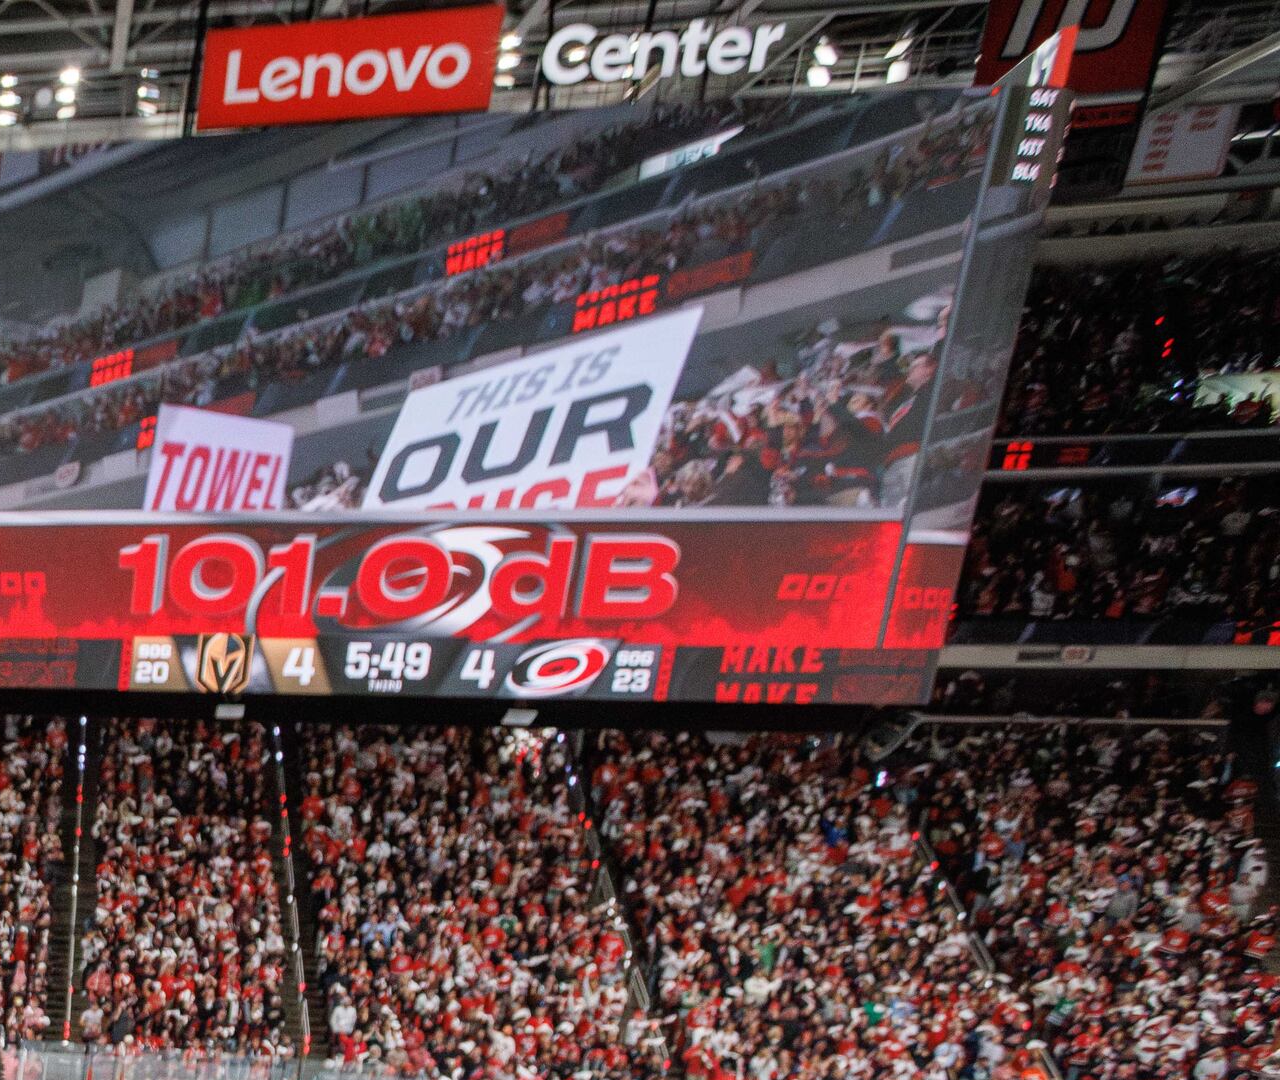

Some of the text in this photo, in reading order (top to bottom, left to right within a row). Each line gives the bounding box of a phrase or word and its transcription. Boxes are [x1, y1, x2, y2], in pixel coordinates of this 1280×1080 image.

[223, 19, 786, 105] Lenovo Center
[447, 344, 623, 423] THIS IS
[378, 383, 653, 504] OUR
[118, 532, 681, 620] 101.0 dB
[134, 642, 496, 689] 20 4 5:49 4
[611, 668, 653, 693] 23
[720, 645, 826, 674] MAKE
